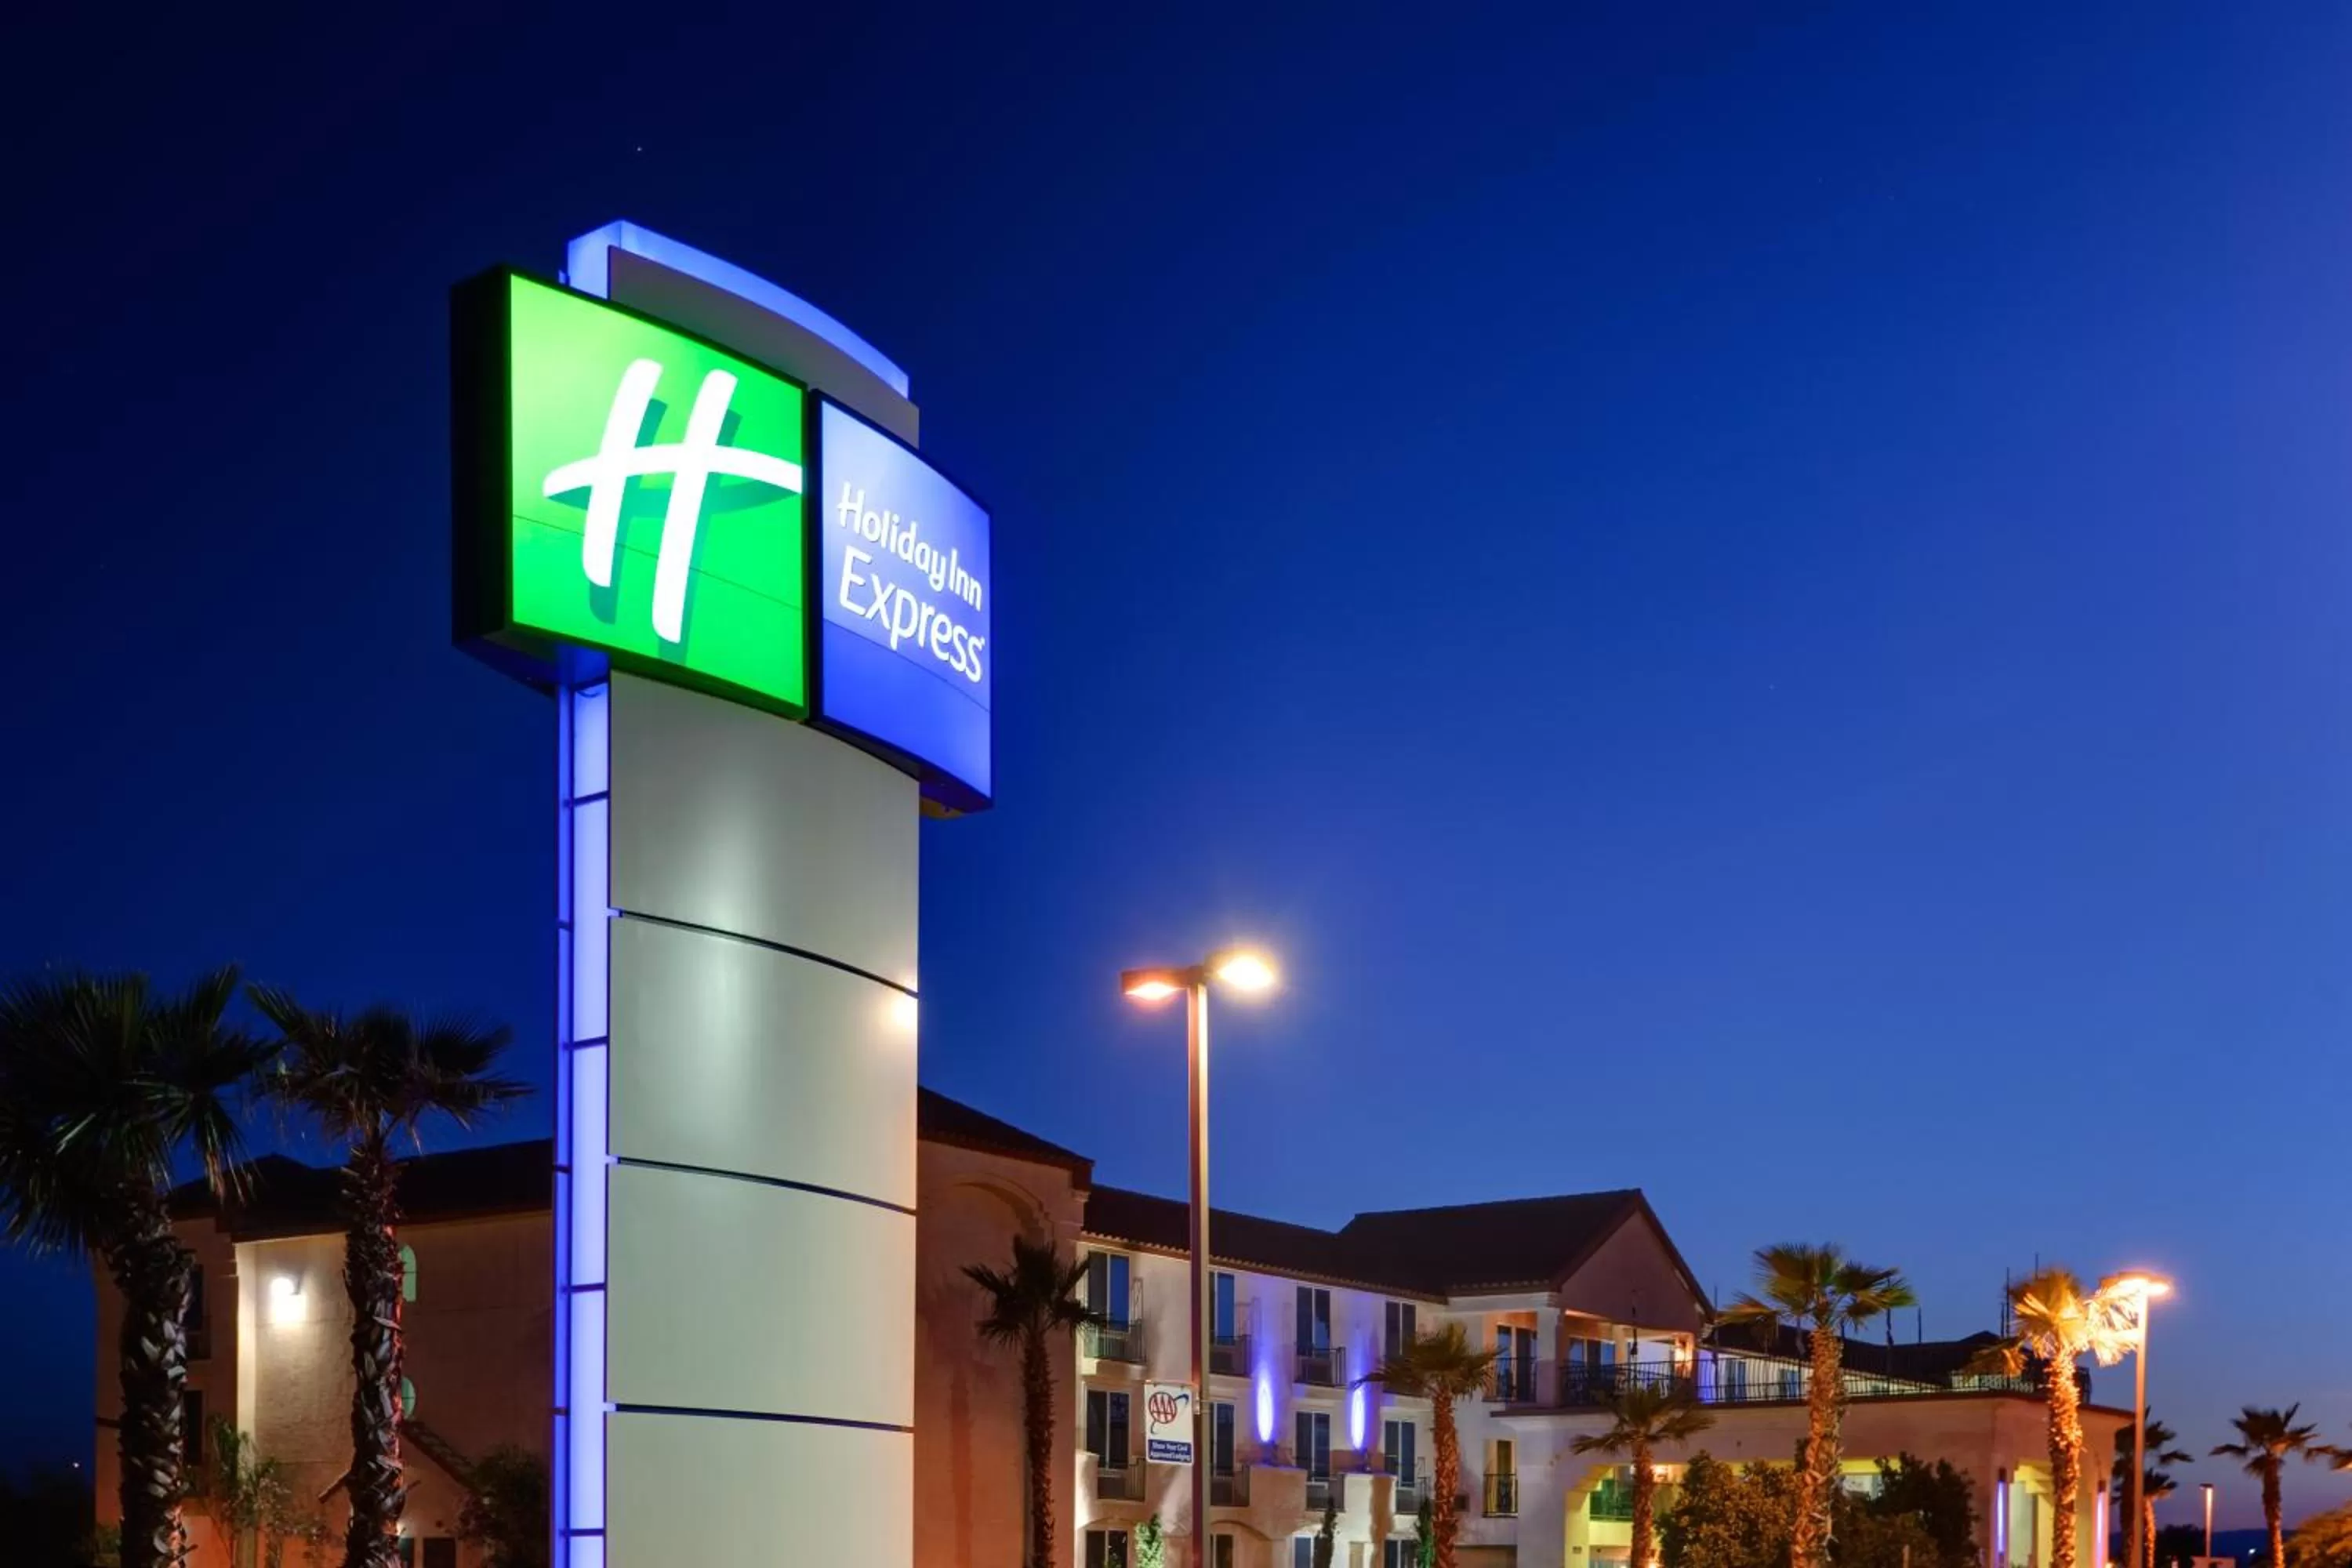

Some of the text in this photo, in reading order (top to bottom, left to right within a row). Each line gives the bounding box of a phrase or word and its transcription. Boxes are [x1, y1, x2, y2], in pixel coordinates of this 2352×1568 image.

[837, 481, 983, 612] Holiday Inn
[839, 543, 984, 683] Express
[1150, 1394, 1175, 1421] AAA
